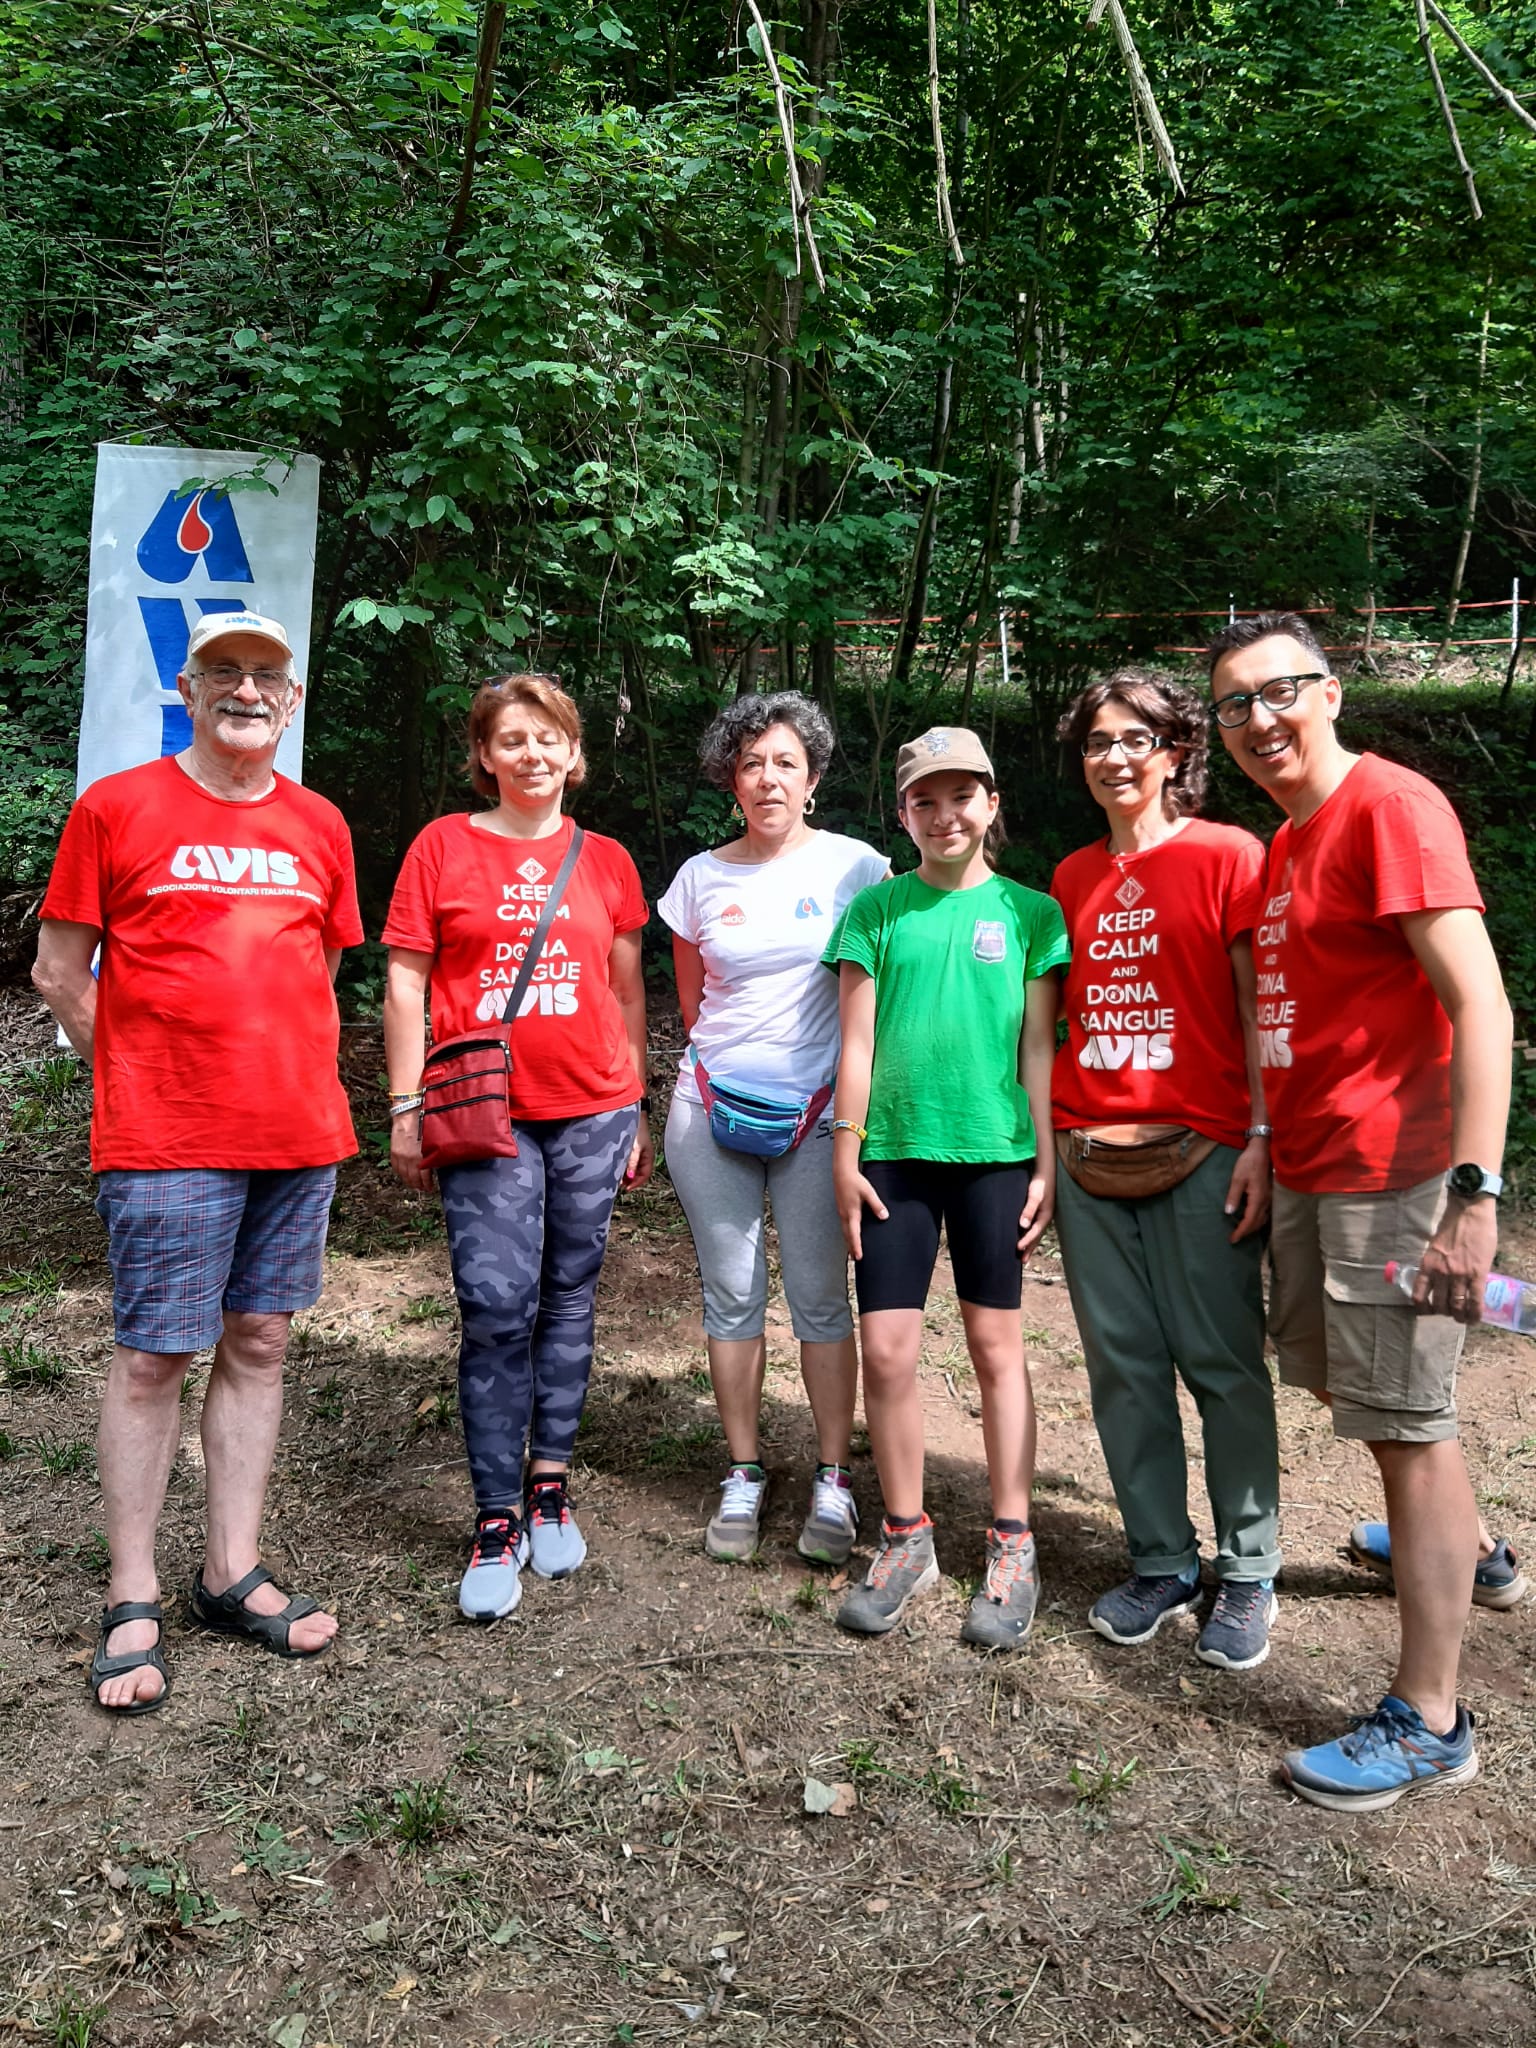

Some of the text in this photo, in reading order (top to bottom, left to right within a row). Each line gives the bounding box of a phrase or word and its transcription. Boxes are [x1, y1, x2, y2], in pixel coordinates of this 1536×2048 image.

[170, 845, 299, 886] AVIS
[147, 883, 209, 897] ASSOCIAZIONE
[211, 885, 259, 896] VOLONTARI
[1265, 891, 1292, 918] KEEP
[519, 927, 538, 937] AN
[1097, 908, 1156, 934] KEEP
[1257, 919, 1287, 947] CALM
[1088, 934, 1159, 961] CALM
[1110, 965, 1139, 978] AND
[1086, 981, 1160, 1006] DONA
[1078, 1032, 1174, 1071] AVIS
